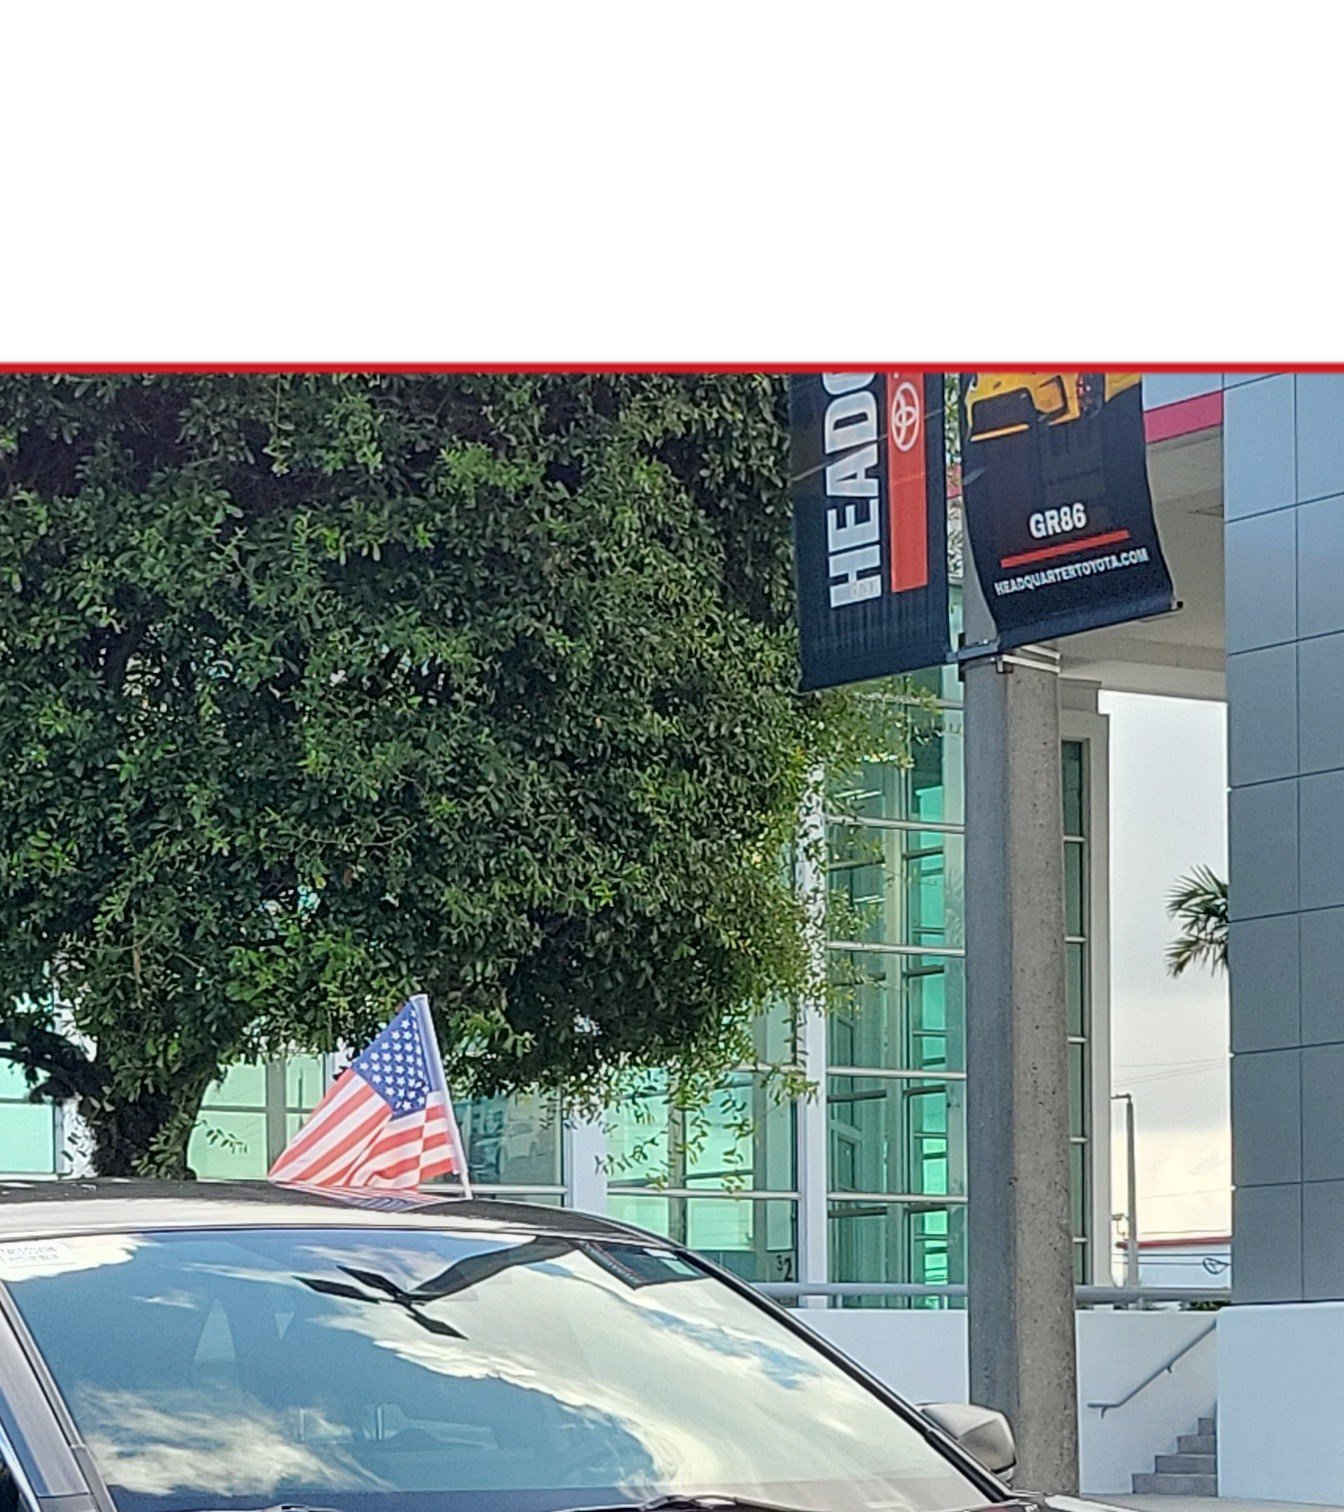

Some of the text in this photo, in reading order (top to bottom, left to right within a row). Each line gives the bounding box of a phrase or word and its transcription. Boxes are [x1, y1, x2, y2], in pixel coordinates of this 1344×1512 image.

[1029, 502, 1087, 539] GR86
[994, 547, 1150, 597] HEADQUARTERTOYOTA.COM
[776, 1254, 794, 1282] 32
